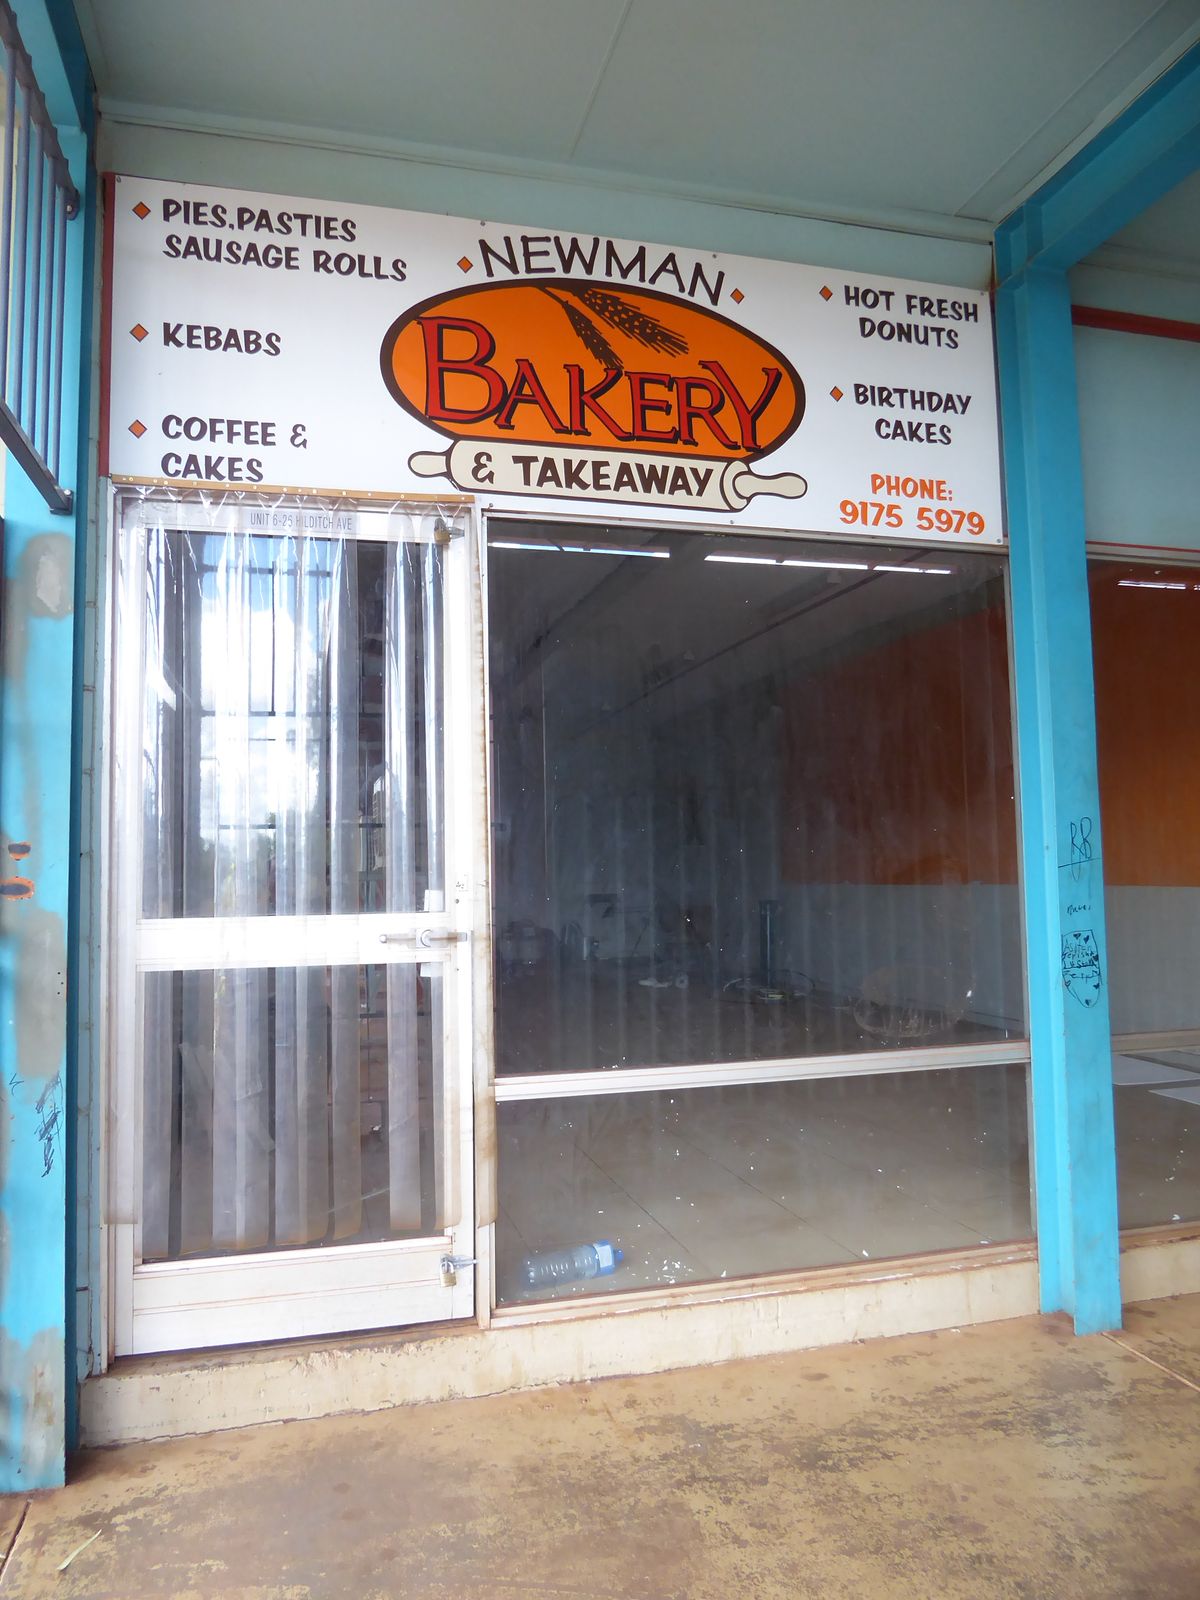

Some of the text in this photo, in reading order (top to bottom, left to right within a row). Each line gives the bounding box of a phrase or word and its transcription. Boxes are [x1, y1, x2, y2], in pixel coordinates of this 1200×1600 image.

[163, 234, 407, 282] SAUSAGE ROLLS
[478, 236, 725, 306] NEWMAN
[844, 285, 979, 323] HOT FRESH
[162, 322, 281, 356] KEBABS
[859, 317, 959, 350] DONUTS
[416, 315, 783, 454] BAKERY
[853, 383, 972, 415] BIRTHDAY
[161, 414, 308, 449] COFFEE &
[875, 418, 952, 446] CAKES
[160, 452, 264, 483] CAKES
[470, 451, 715, 498] & TAKEAWAY
[870, 473, 953, 501] PHONE:
[250, 512, 270, 526] UNIT
[336, 516, 353, 531] AVE
[839, 499, 985, 535] 9175 5979
